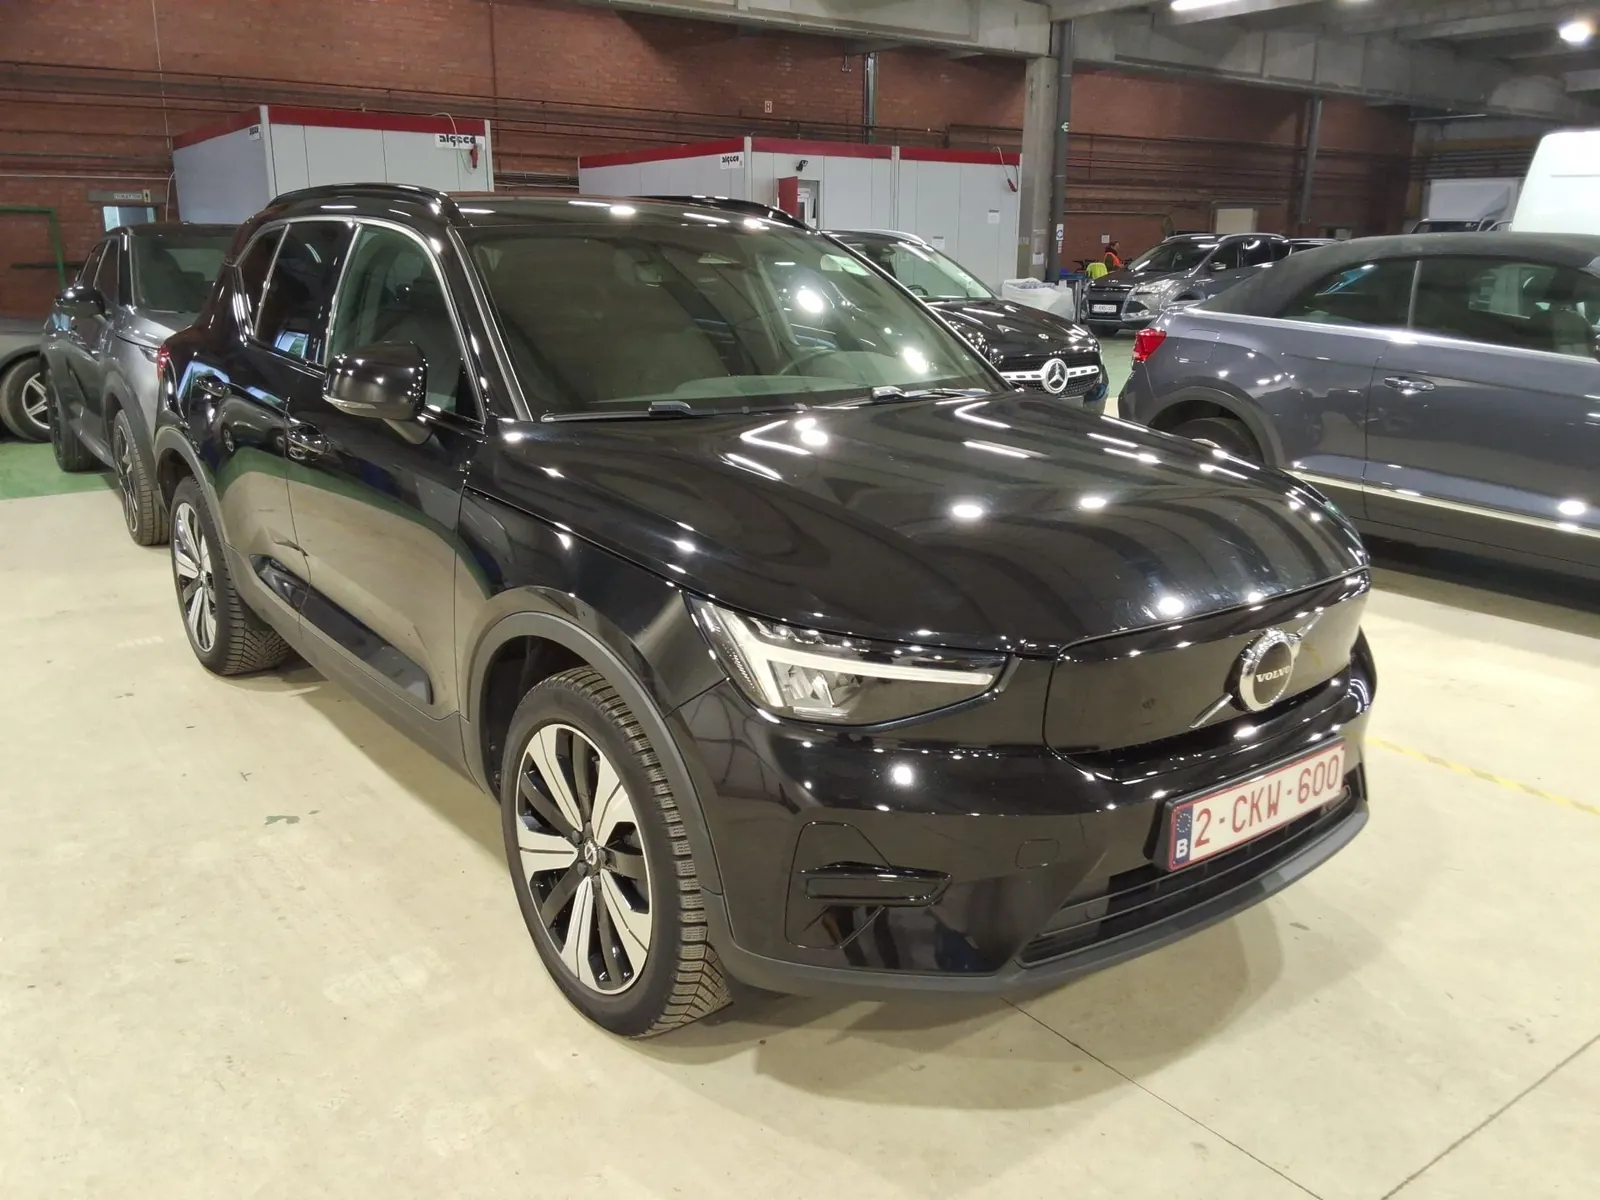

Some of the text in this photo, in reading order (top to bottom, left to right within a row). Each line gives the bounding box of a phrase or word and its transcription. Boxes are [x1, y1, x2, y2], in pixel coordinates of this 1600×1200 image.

[1256, 665, 1291, 683] VOLVO
[1194, 754, 1339, 848] 2-CKW-600
[1176, 838, 1189, 859] B
